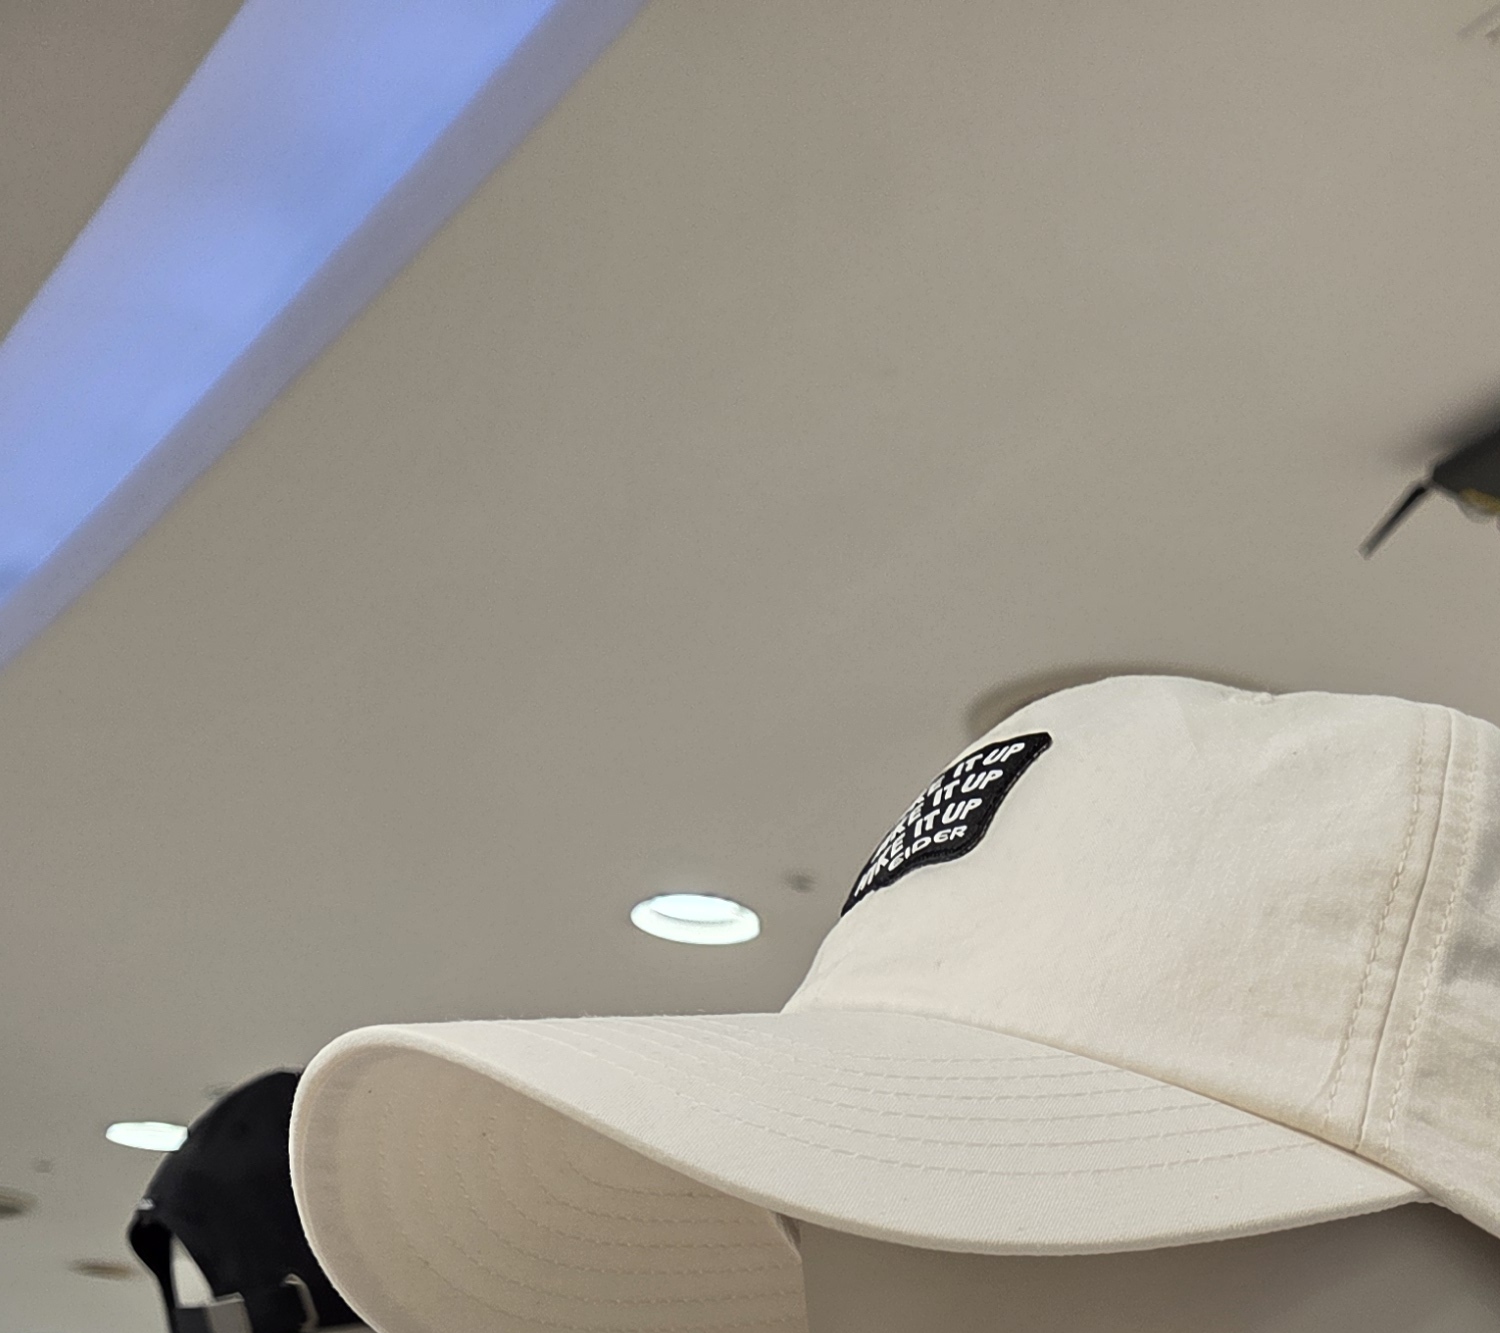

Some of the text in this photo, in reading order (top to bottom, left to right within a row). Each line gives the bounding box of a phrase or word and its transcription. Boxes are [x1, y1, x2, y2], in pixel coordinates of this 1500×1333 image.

[952, 753, 983, 779] IT
[982, 742, 1025, 766] UP
[932, 778, 960, 807] IT
[961, 769, 1003, 793] UP
[914, 809, 940, 838] IT
[941, 798, 982, 825] UP
[888, 825, 967, 872] EIDER
